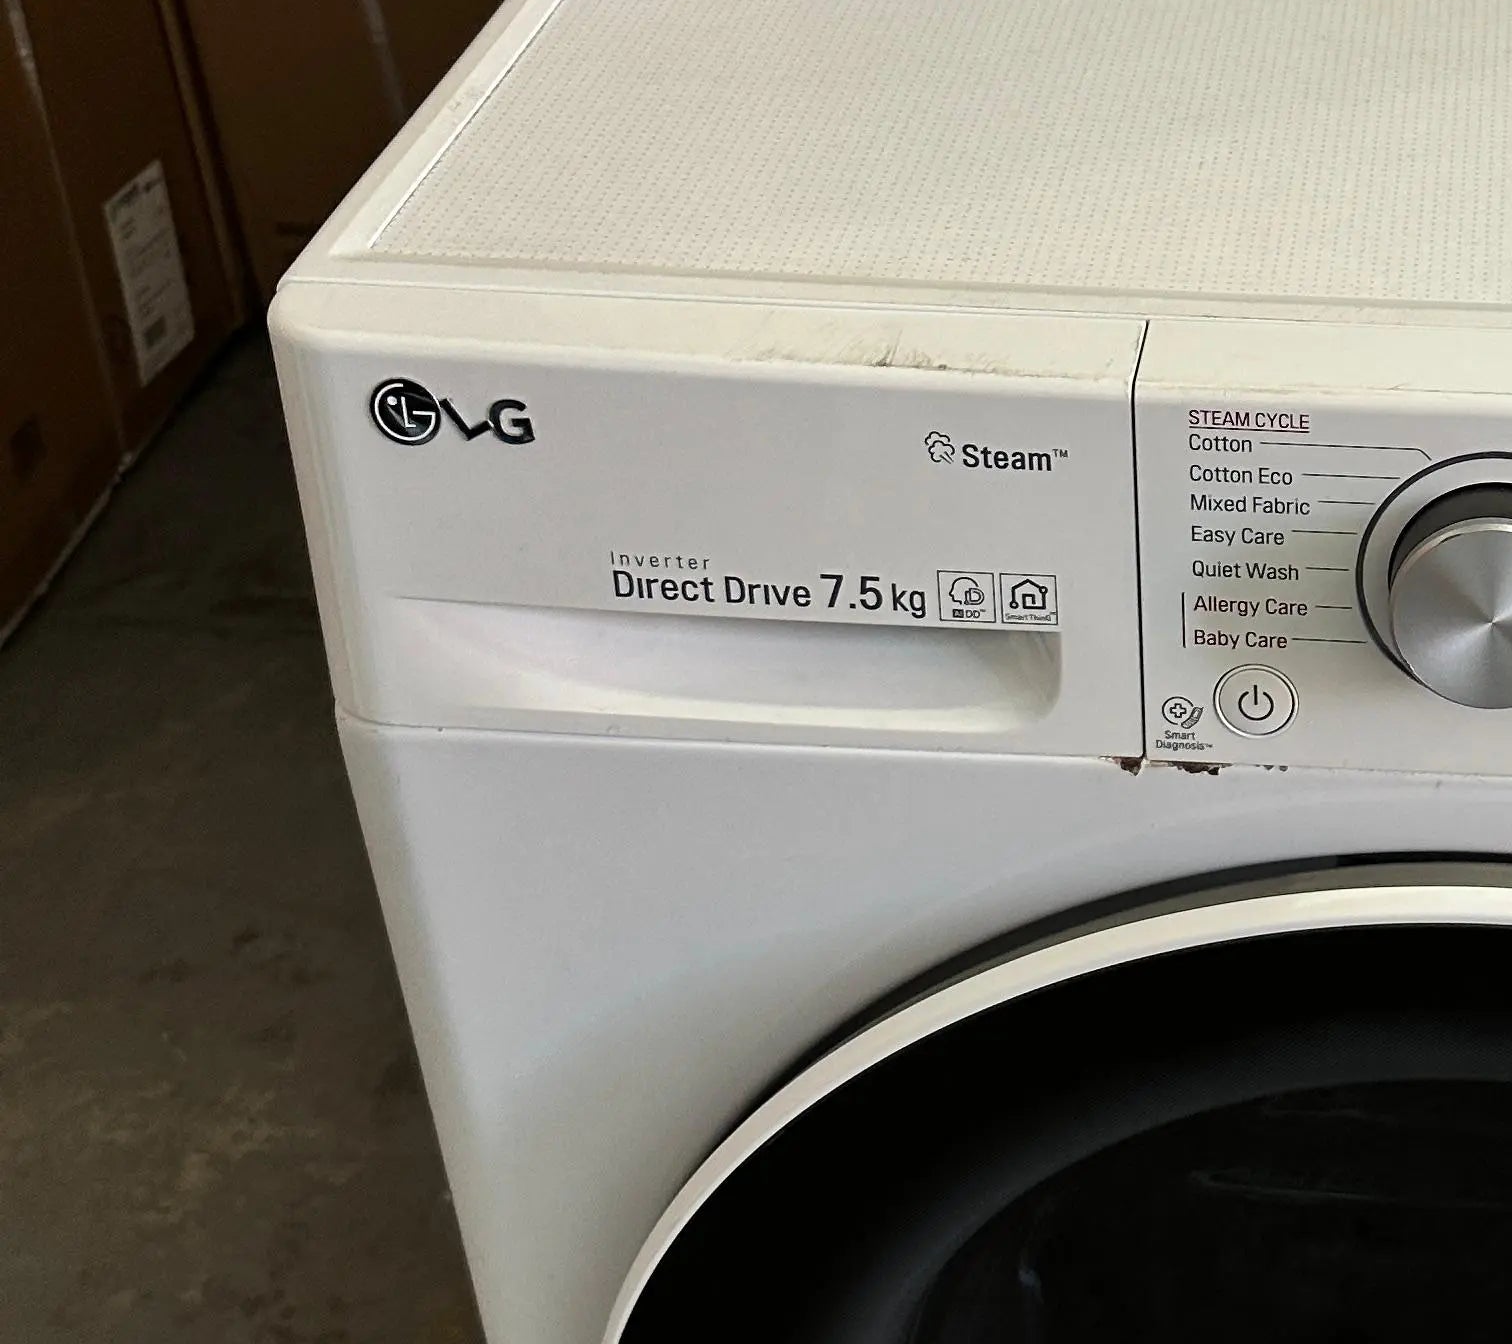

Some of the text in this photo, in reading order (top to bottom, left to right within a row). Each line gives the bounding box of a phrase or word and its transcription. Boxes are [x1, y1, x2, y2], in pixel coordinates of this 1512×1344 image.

[440, 398, 536, 445] LG
[1188, 410, 1310, 430] STEAM CYCLE
[1188, 434, 1252, 453] Cotton
[1190, 465, 1293, 485] Cotton Eco
[1190, 494, 1311, 516] Mixed Fabric
[1191, 525, 1285, 546] Easy Care
[610, 551, 711, 570] Inverter
[1192, 560, 1299, 581] Quiet Wash
[612, 570, 927, 618] Direct Drive 7.5 kg
[1193, 595, 1308, 617] Allergy Care
[1194, 629, 1288, 649] Baby Care
[1164, 729, 1196, 741] Smart
